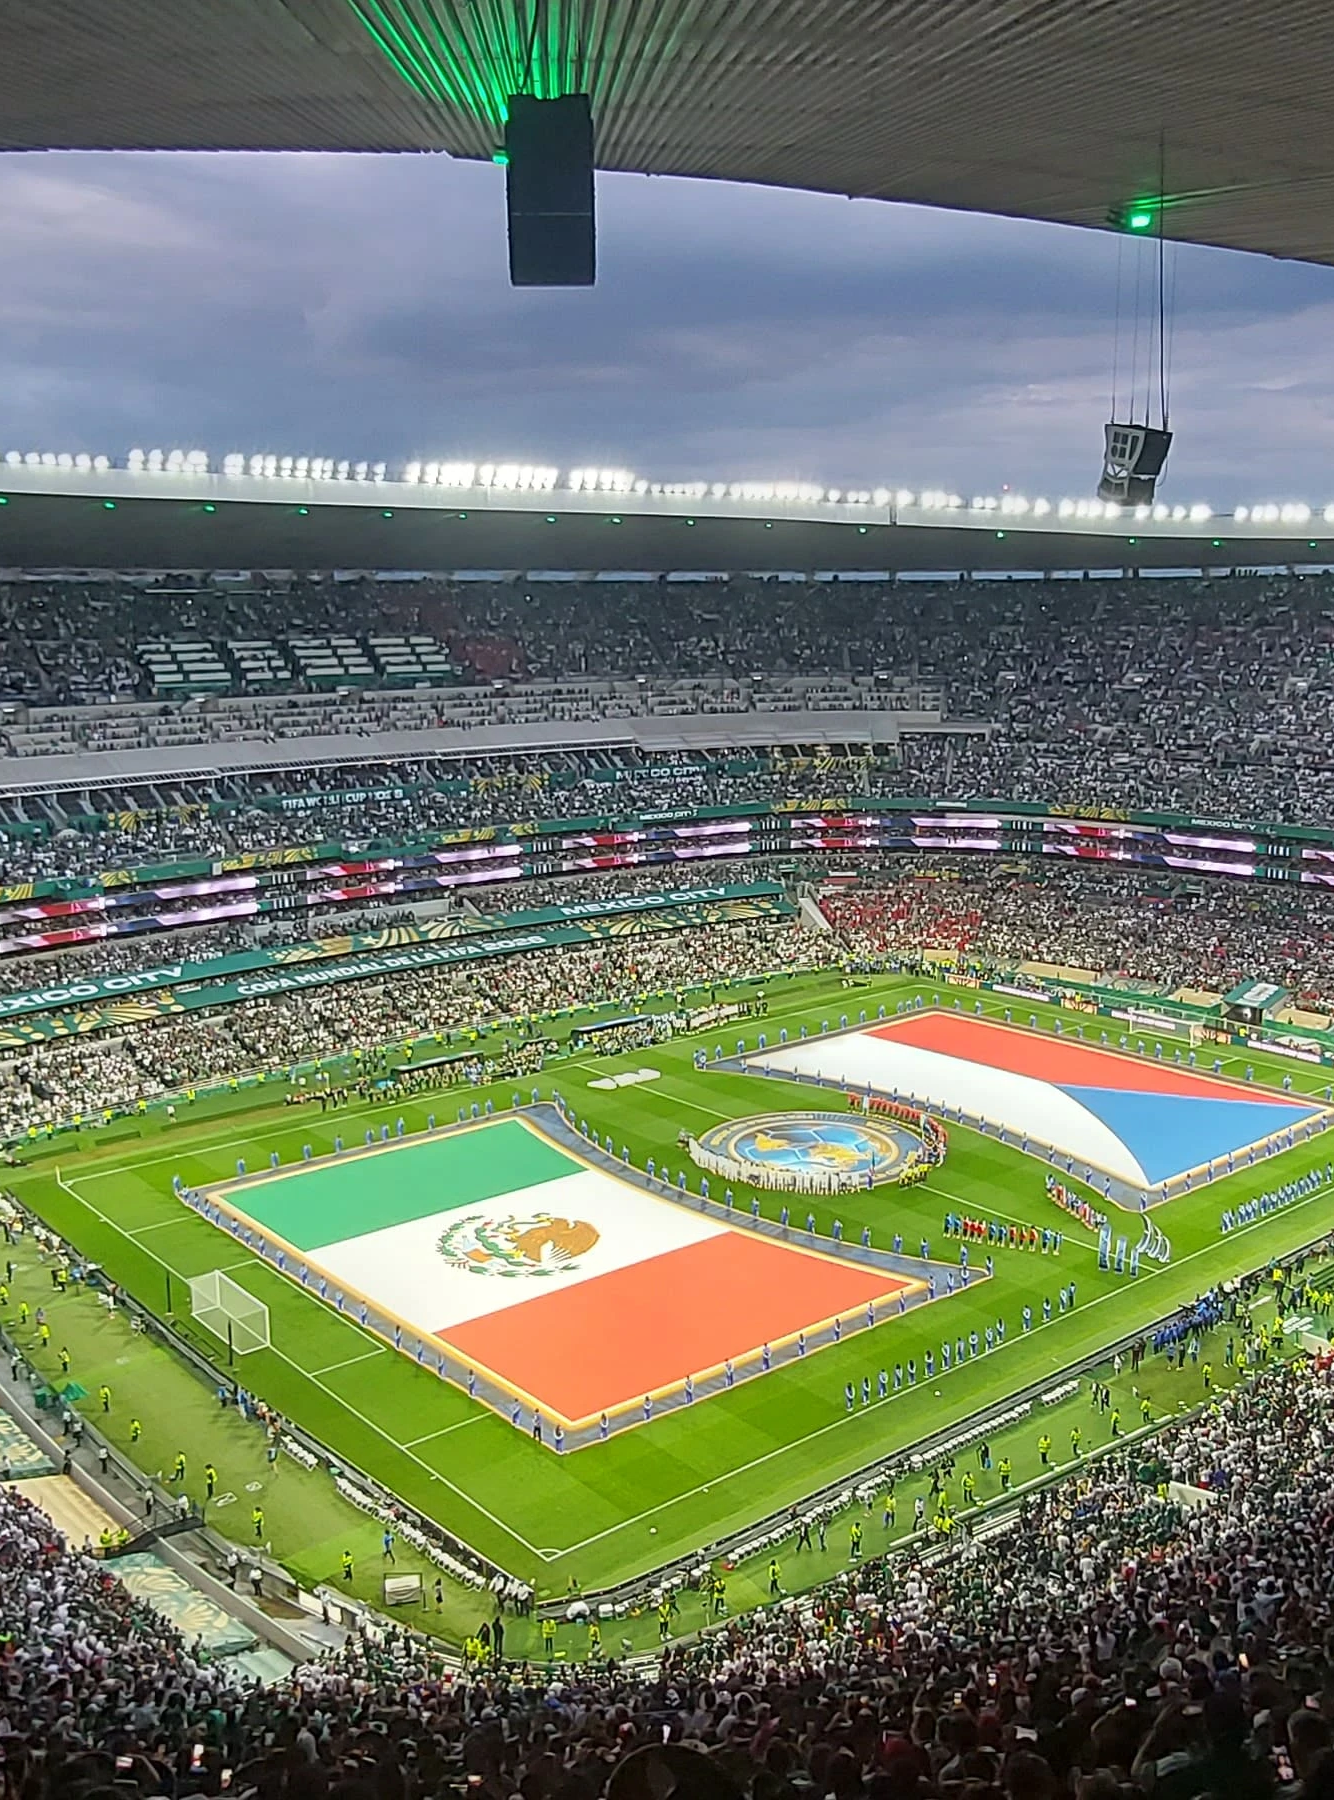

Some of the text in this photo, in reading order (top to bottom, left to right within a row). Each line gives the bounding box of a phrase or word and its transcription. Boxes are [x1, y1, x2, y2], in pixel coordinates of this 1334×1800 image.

[616, 767, 670, 780] MICO
[282, 798, 305, 810] FIFA
[345, 791, 366, 803] CUP
[369, 789, 404, 801] 026
[560, 887, 725, 915] MEXICO CITY
[103, 965, 185, 990] CITY
[237, 935, 547, 996] COPA MUNDIAL DE LA FIFA 2026
